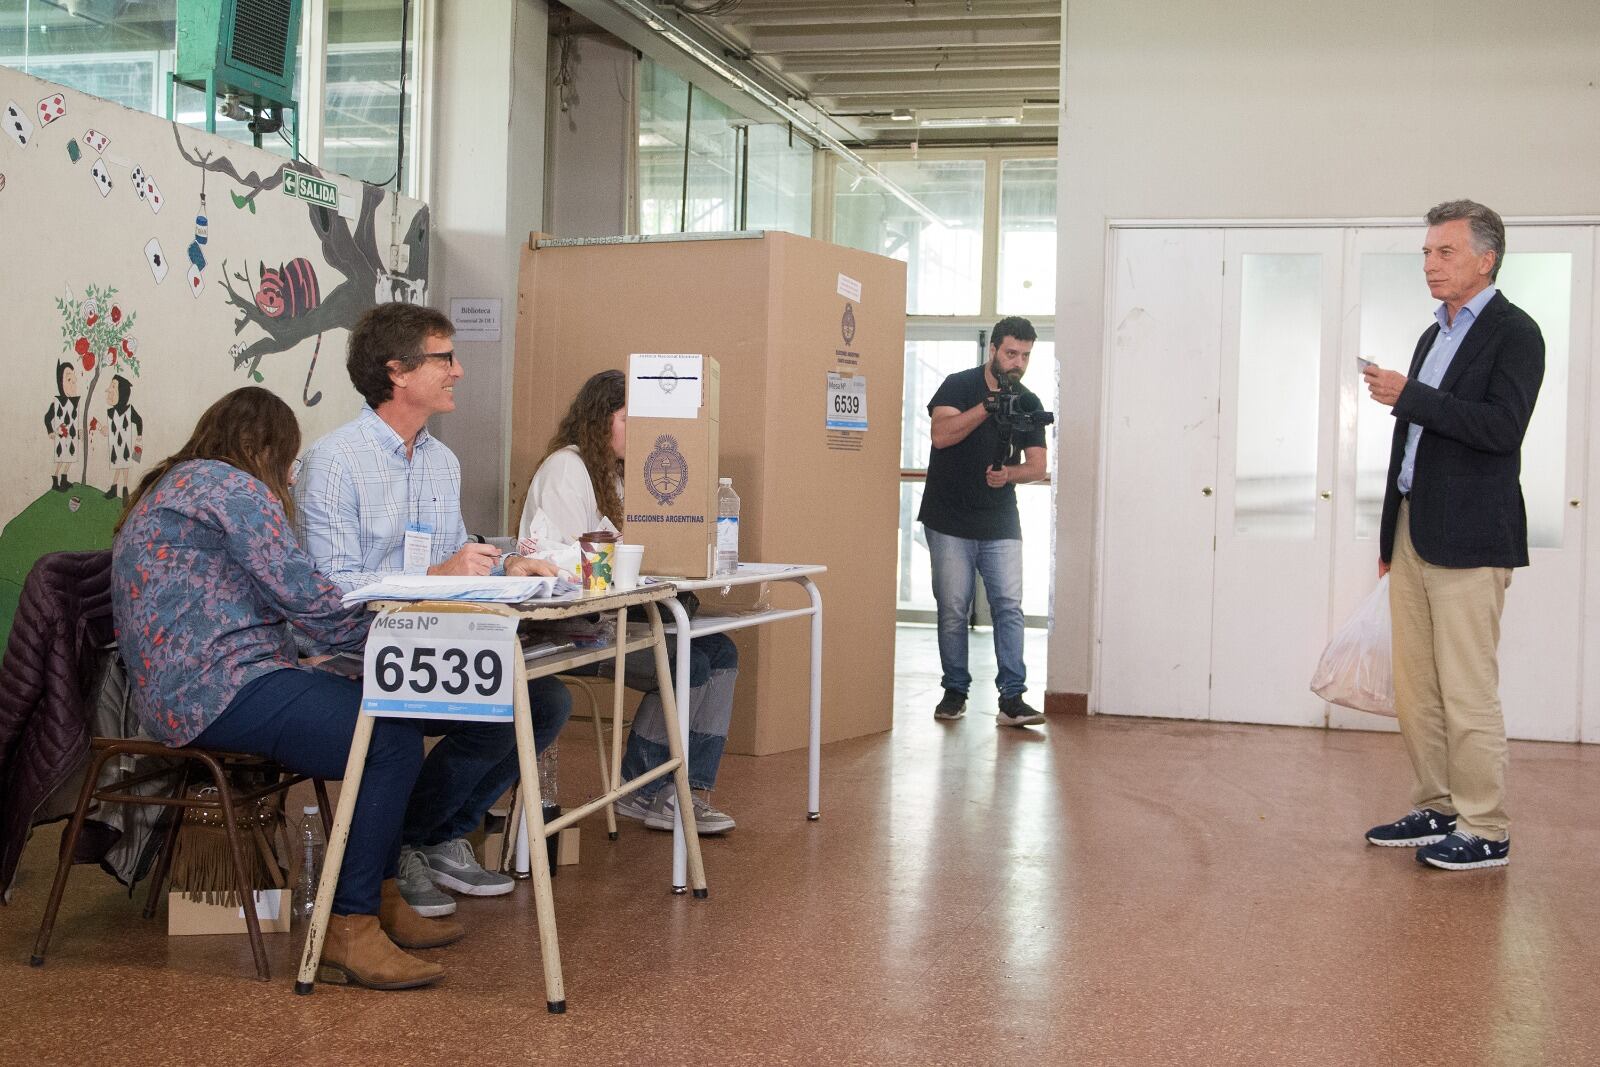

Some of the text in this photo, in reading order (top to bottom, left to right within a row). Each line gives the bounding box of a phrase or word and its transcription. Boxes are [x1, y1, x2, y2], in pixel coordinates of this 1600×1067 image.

[300, 179, 336, 204] SALIDA
[461, 306, 491, 314] Biblioteca
[834, 394, 860, 414] 6539
[626, 514, 704, 524] ELECCIONES ARGENTINAS
[374, 615, 414, 630] Mesa
[374, 645, 503, 697] 6539
